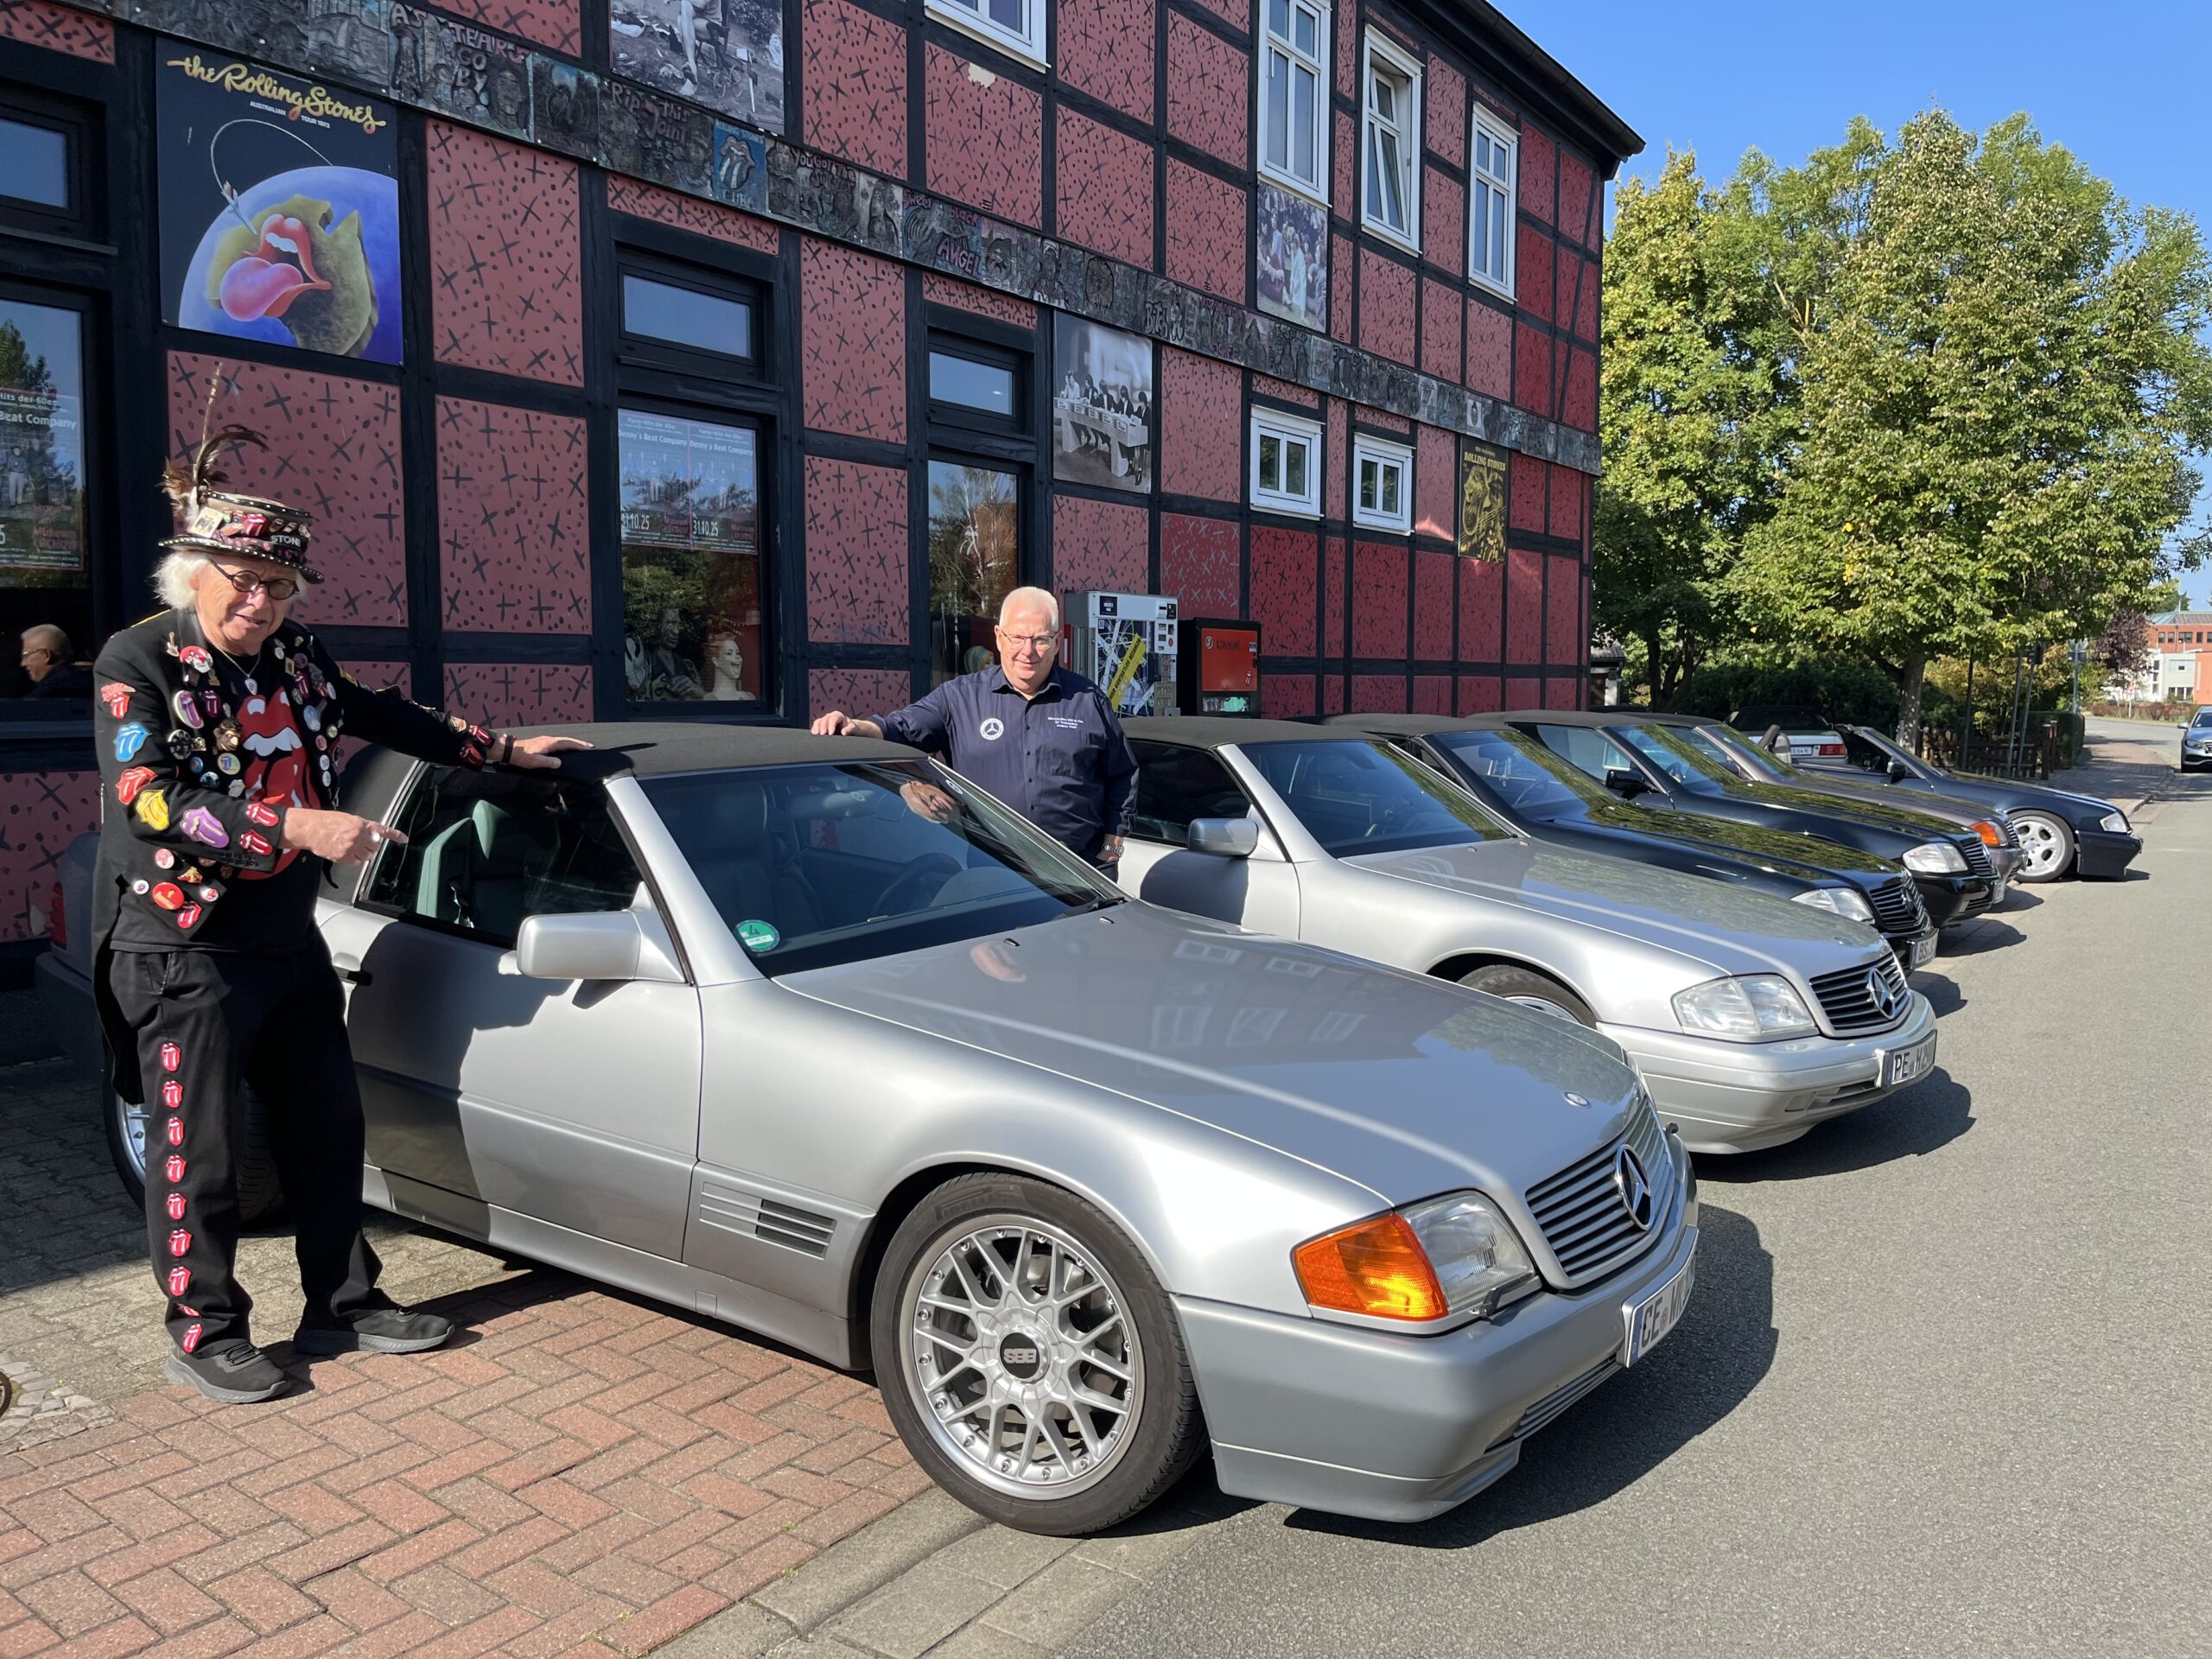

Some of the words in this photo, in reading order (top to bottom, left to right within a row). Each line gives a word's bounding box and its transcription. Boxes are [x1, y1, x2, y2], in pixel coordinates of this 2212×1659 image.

[449, 22, 531, 64] TEARS
[457, 47, 487, 71] GO
[456, 67, 488, 93] BY
[167, 55, 216, 83] the
[221, 63, 303, 121] Rolling
[303, 86, 386, 134] Stones
[611, 81, 640, 113] Rip
[250, 100, 286, 116] AUSTRALIAN
[301, 114, 317, 124] TOUR
[741, 128, 765, 144] STONES
[723, 190, 754, 208] CUBA
[938, 238, 981, 278] ANGEL
[26, 414, 77, 430] Company
[644, 433, 658, 442] Beat
[659, 435, 687, 447] Company
[714, 442, 727, 451] Beat
[728, 445, 753, 456] Company
[1465, 452, 1486, 467] ROLLING
[1487, 459, 1505, 471] STONES
[693, 520, 718, 536] 31.10.25
[1895, 1052, 1910, 1080] PE
[1642, 1297, 1663, 1348] CE
